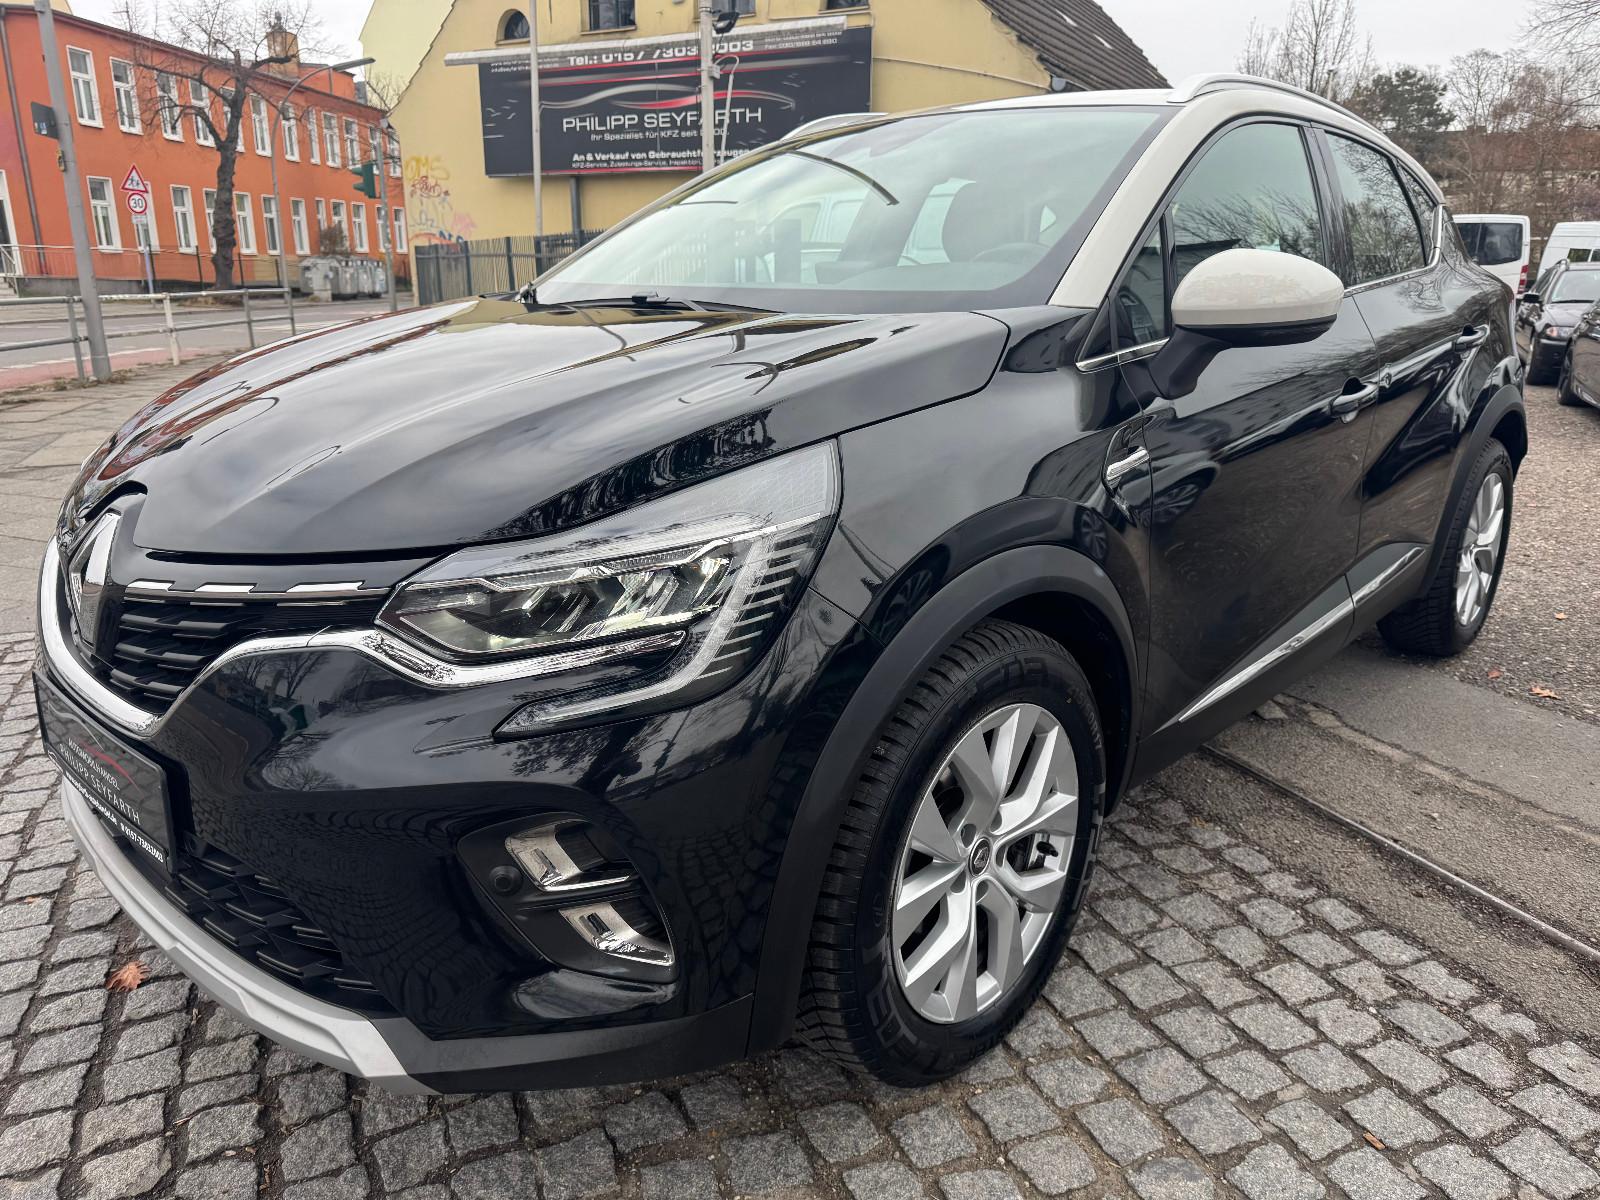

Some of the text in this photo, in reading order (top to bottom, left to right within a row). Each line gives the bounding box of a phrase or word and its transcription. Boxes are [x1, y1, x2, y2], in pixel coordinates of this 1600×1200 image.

[567, 55, 598, 66] Tel.:
[562, 107, 762, 133] PHILIPP SEYFRTH
[590, 134, 603, 142] Ihr
[604, 131, 644, 142] Spezialist
[660, 129, 680, 138] KFZ
[681, 129, 698, 138] seit
[573, 153, 585, 162] An
[586, 153, 593, 161] &
[595, 151, 629, 161] Verkauf
[631, 151, 647, 160] von
[131, 198, 144, 209] 30
[91, 774, 141, 825] SEYFARTH
